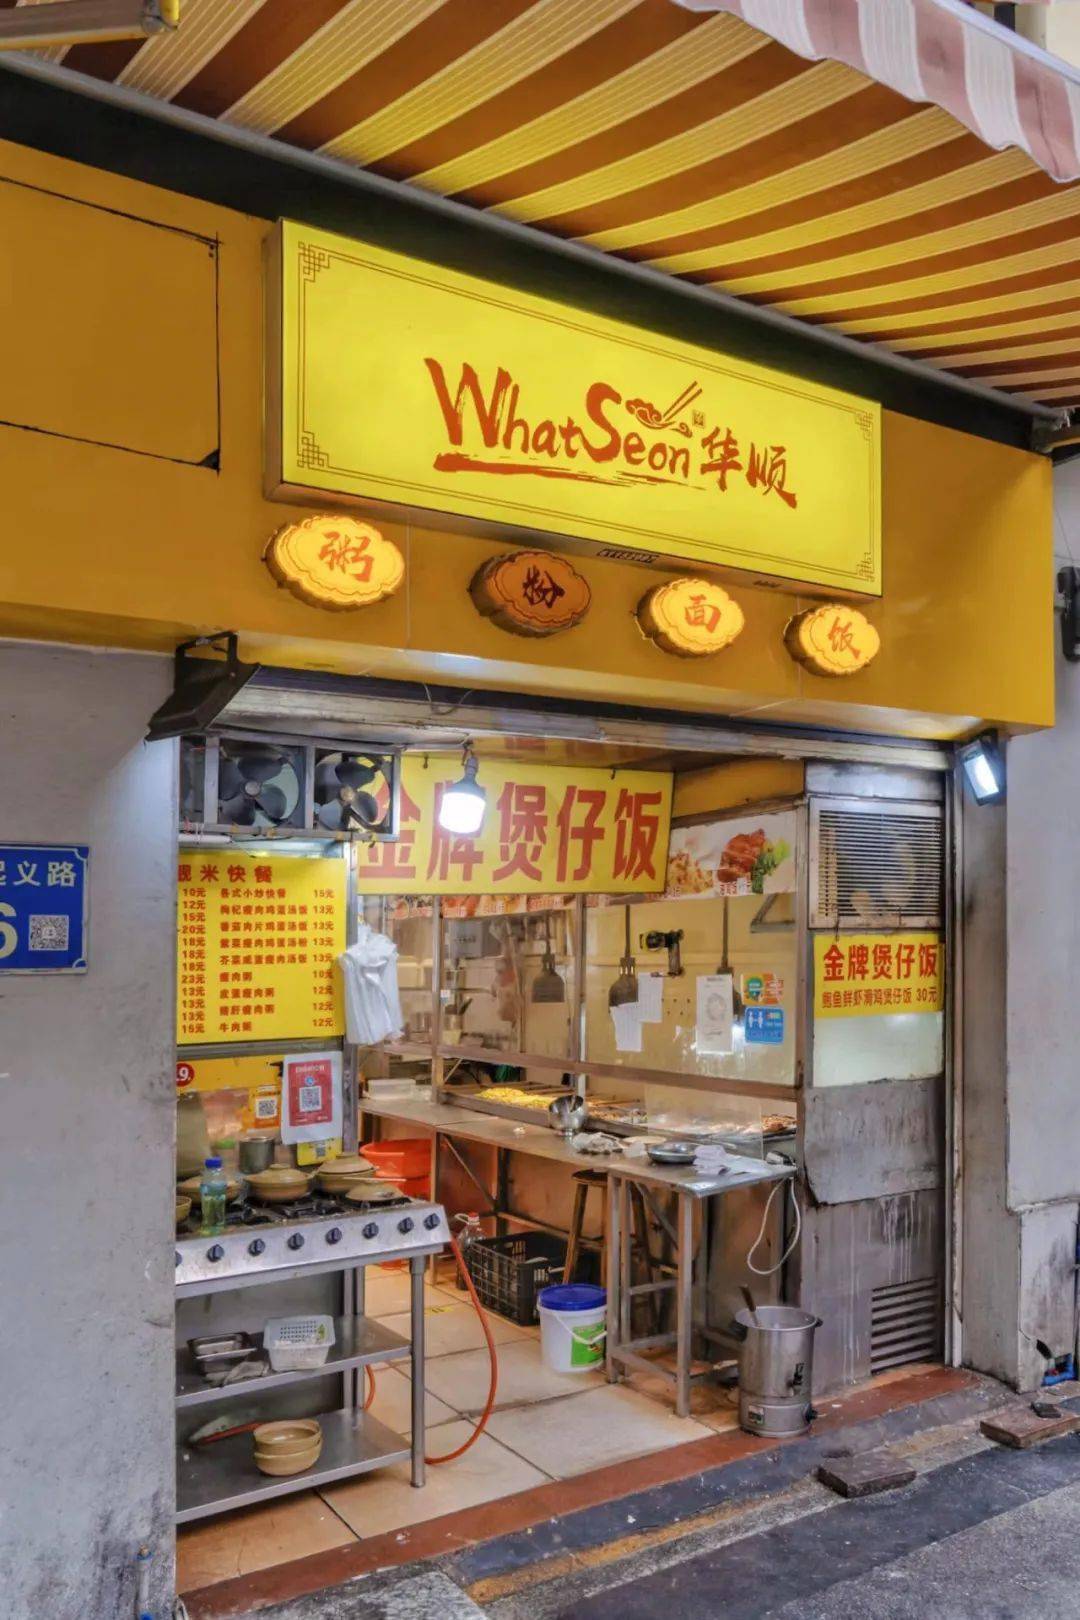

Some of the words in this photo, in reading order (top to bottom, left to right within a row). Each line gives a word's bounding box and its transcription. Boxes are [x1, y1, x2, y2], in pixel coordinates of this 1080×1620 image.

[424, 358, 690, 478] WhatSeon
[700, 426, 798, 510] 华顺
[318, 531, 374, 583] 粥
[521, 564, 562, 609] 粉
[683, 593, 721, 633] 面
[828, 615, 862, 659] 饭
[0, 861, 77, 887] 义路
[823, 943, 937, 981] 金牌煲仔饭
